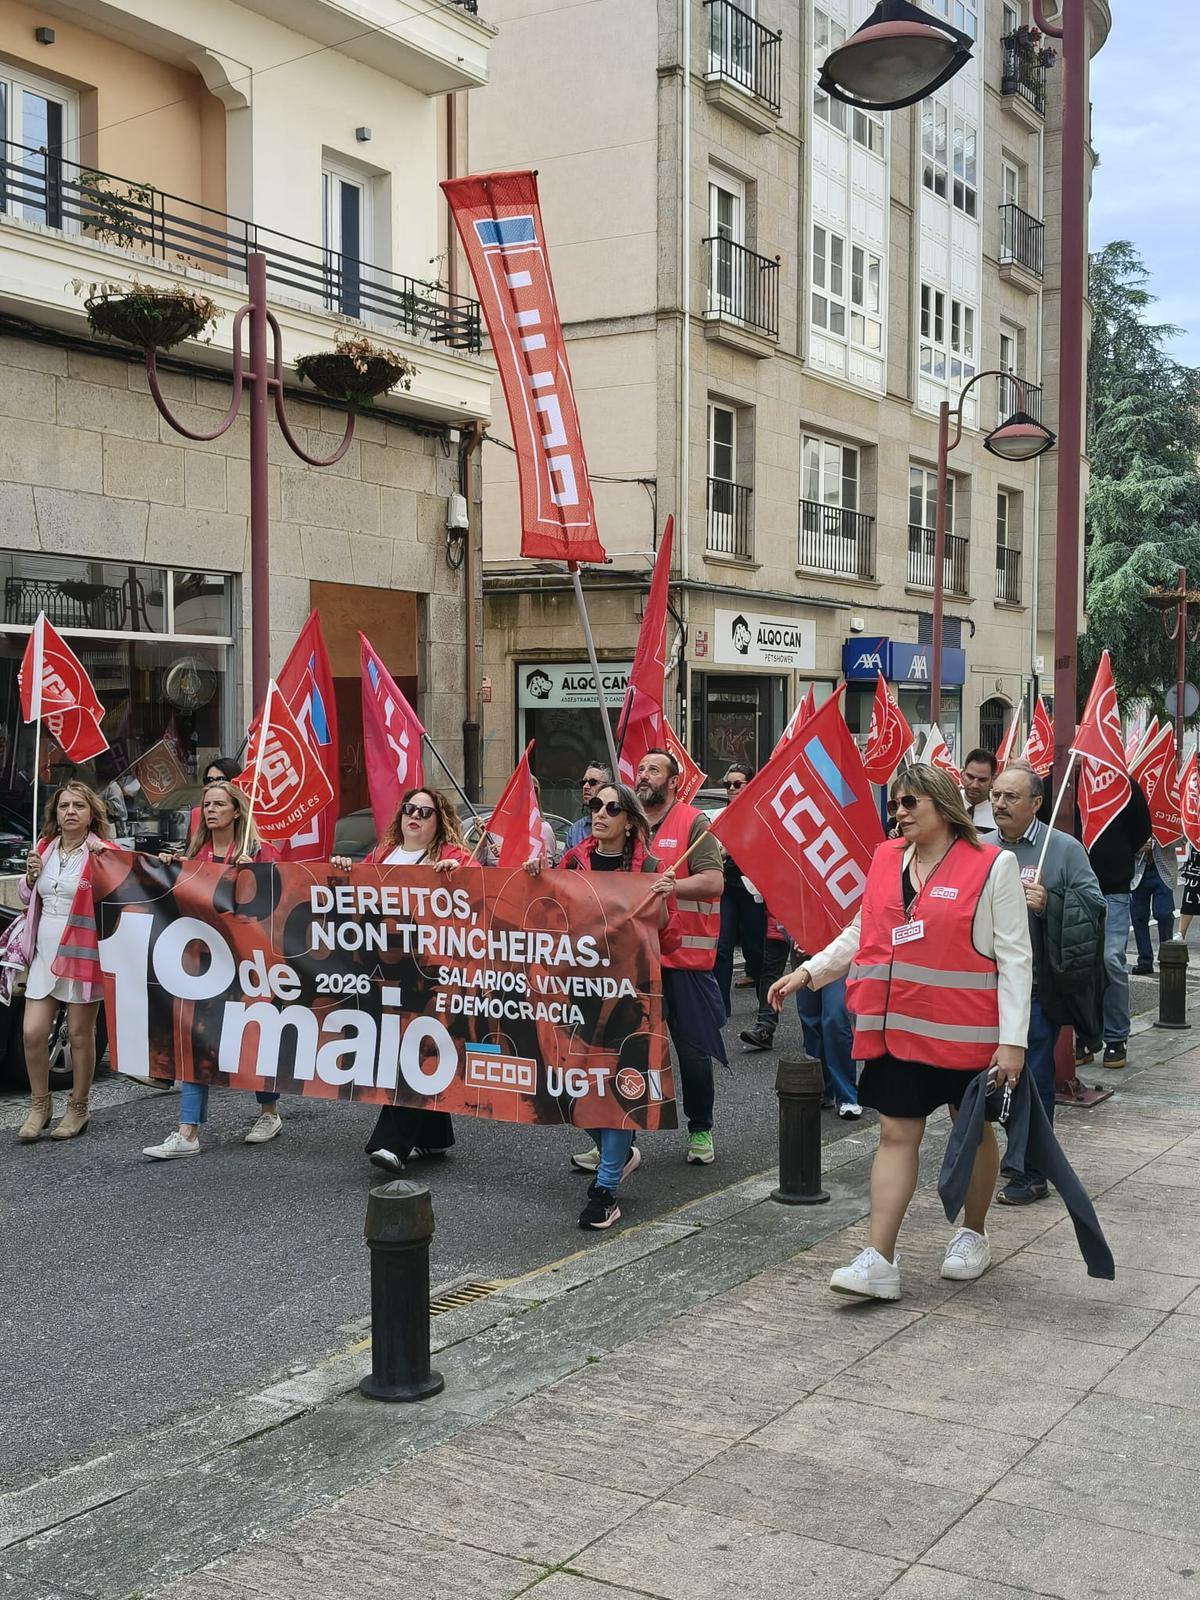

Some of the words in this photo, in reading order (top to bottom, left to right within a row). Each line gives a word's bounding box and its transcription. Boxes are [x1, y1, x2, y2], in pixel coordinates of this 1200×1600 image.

[756, 629, 782, 645] ALQO
[783, 631, 802, 648] CAN
[852, 653, 882, 669] AXA
[907, 655, 927, 679] AXA
[770, 772, 867, 910] CCOO
[1021, 868, 1038, 878] UG
[310, 885, 479, 925] DEREITOS,
[931, 887, 957, 899] CCOO
[311, 921, 388, 952] NON
[396, 923, 611, 968] TRINCHEIRAS.
[238, 949, 302, 1000] de
[315, 973, 371, 994] 2026
[437, 965, 531, 997] SALARIOS,
[536, 975, 638, 998] VIVENDA
[435, 993, 447, 1012] E
[450, 996, 585, 1024] DEMOCRACIA
[218, 986, 458, 1096] maio
[470, 1059, 533, 1085] CCOO
[546, 1065, 611, 1098] UGT
